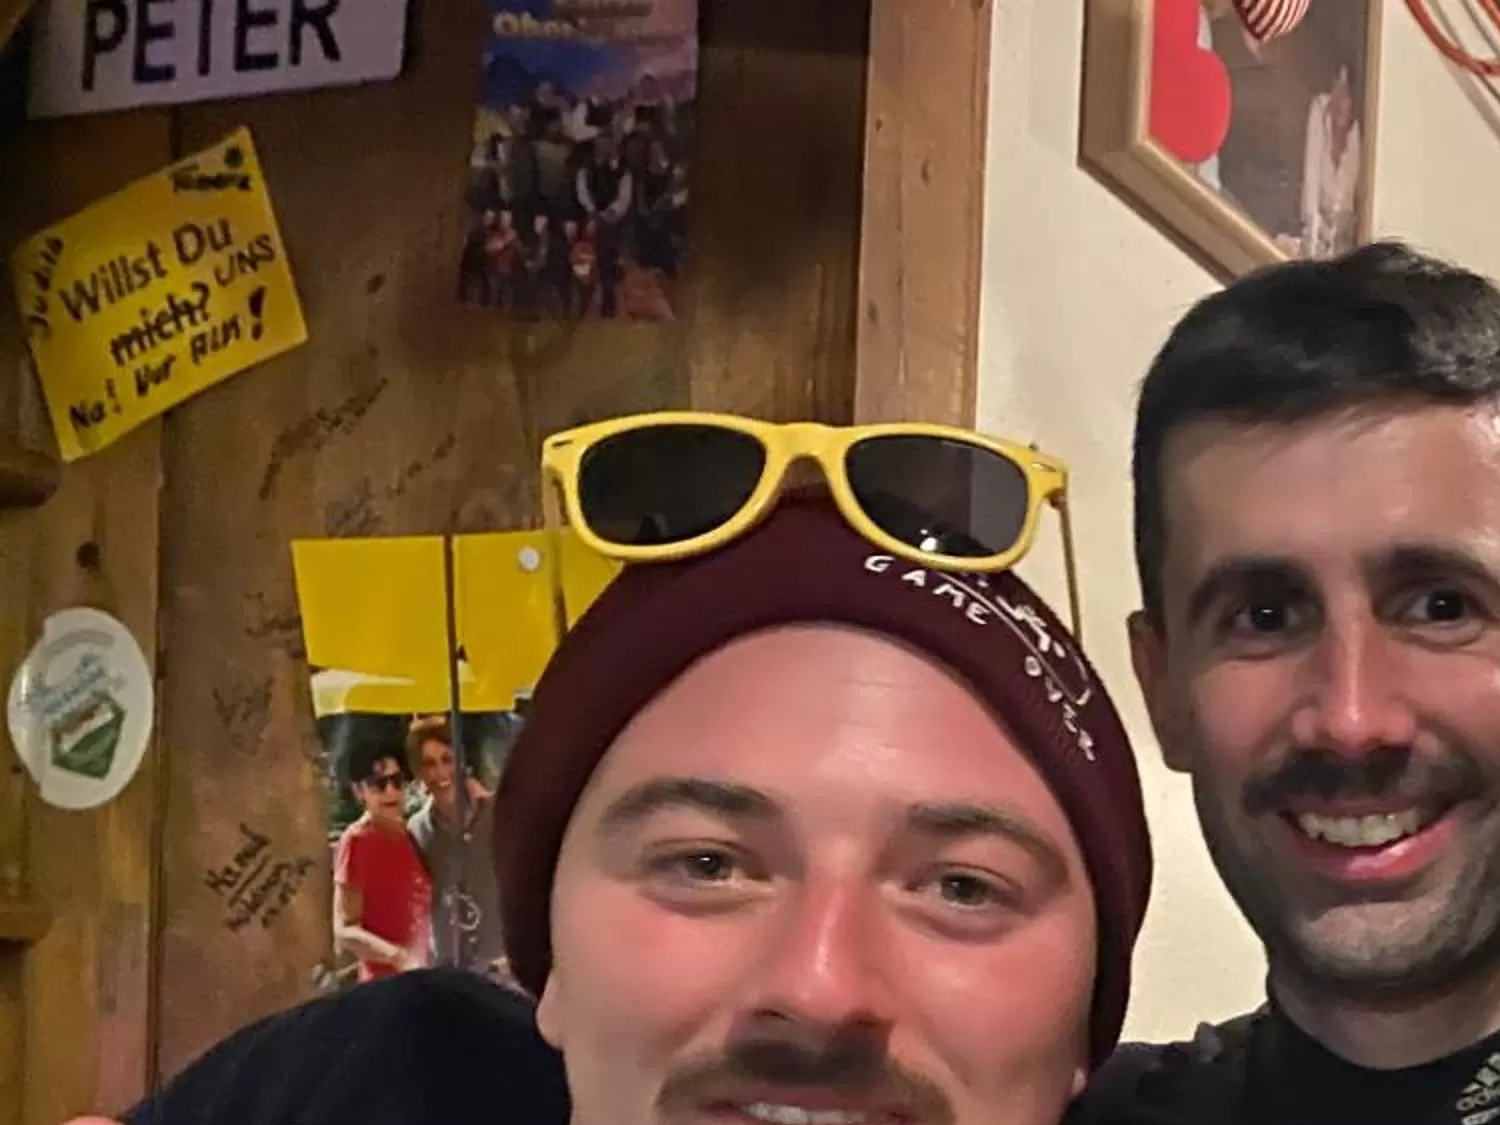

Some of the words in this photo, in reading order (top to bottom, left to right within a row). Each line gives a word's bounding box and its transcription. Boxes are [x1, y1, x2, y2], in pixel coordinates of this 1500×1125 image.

[81, 0, 342, 92] PETER
[58, 240, 170, 323] Willst
[172, 217, 234, 266] Du
[863, 554, 990, 625] GAME
